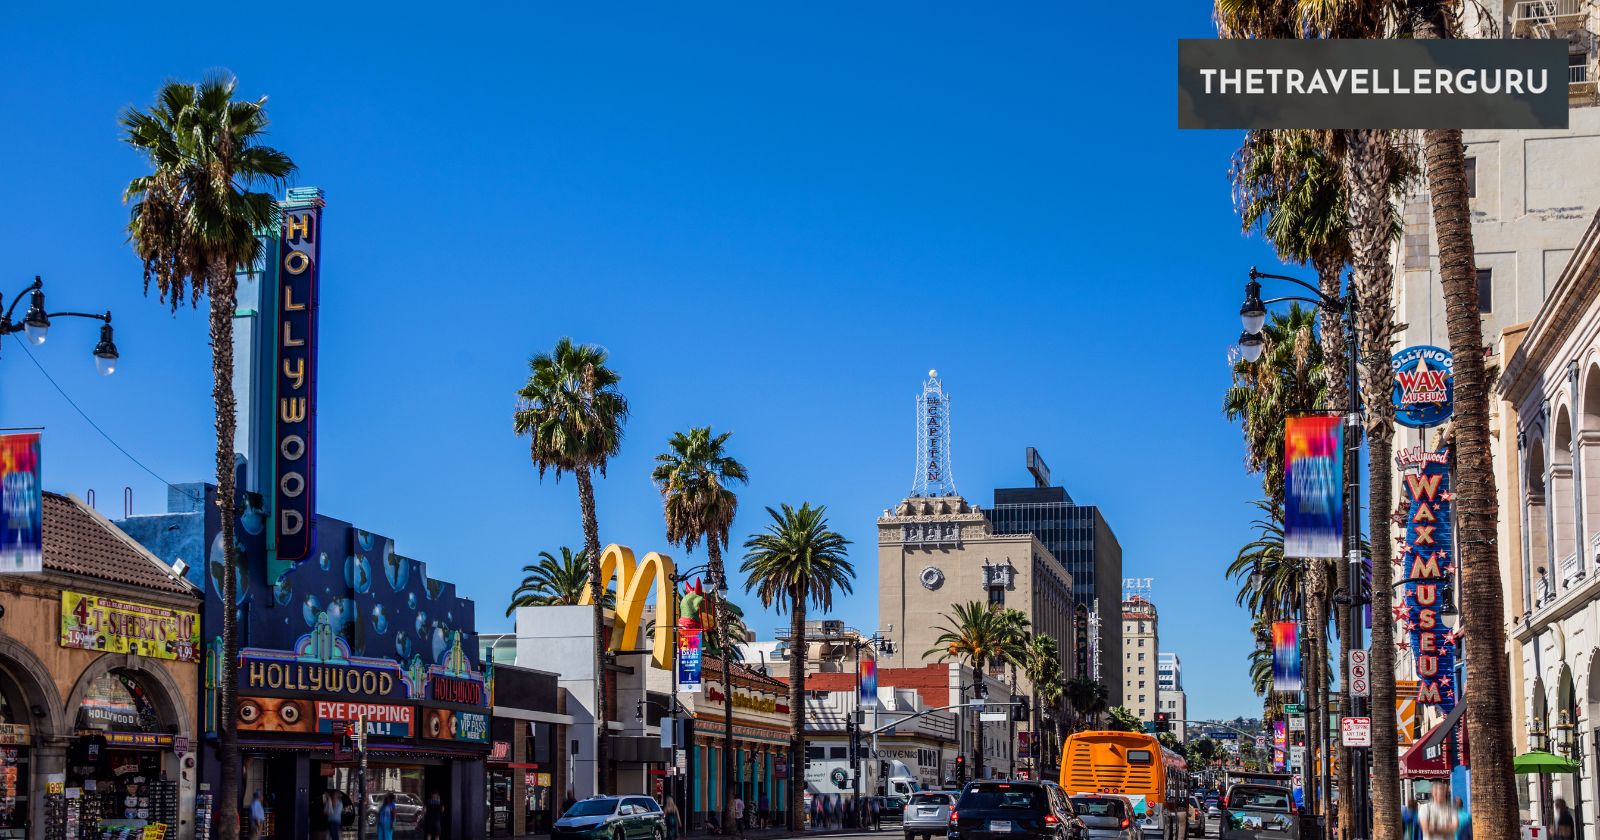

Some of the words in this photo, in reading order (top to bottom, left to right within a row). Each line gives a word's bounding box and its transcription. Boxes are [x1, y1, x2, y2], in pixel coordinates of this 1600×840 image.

[1392, 348, 1453, 375] OLLYWOO
[280, 214, 309, 536] HOLLYWOOD
[1399, 370, 1447, 395] WAX
[1401, 391, 1447, 403] MUSEUM
[927, 407, 939, 481] CAPITAN
[1397, 446, 1450, 469] Hollywood
[1405, 473, 1442, 545] WAX
[73, 597, 90, 625] 4
[93, 608, 167, 642] T-SHIRTS
[1409, 551, 1443, 705] MUSEUM
[68, 630, 85, 645] 1.99
[179, 645, 193, 659] 1.99
[250, 661, 393, 696] HOLLYWOOD
[434, 676, 480, 705] HOLLYWOOD
[88, 709, 135, 724] HOLLYWOOD
[318, 702, 345, 719] EYE
[348, 703, 410, 723] POPPING
[463, 713, 472, 721] GET
[354, 721, 391, 735] EAL!
[461, 719, 471, 731] VIP
[471, 720, 486, 733] PASS
[467, 731, 480, 739] HERE
[176, 738, 187, 746] ATM
